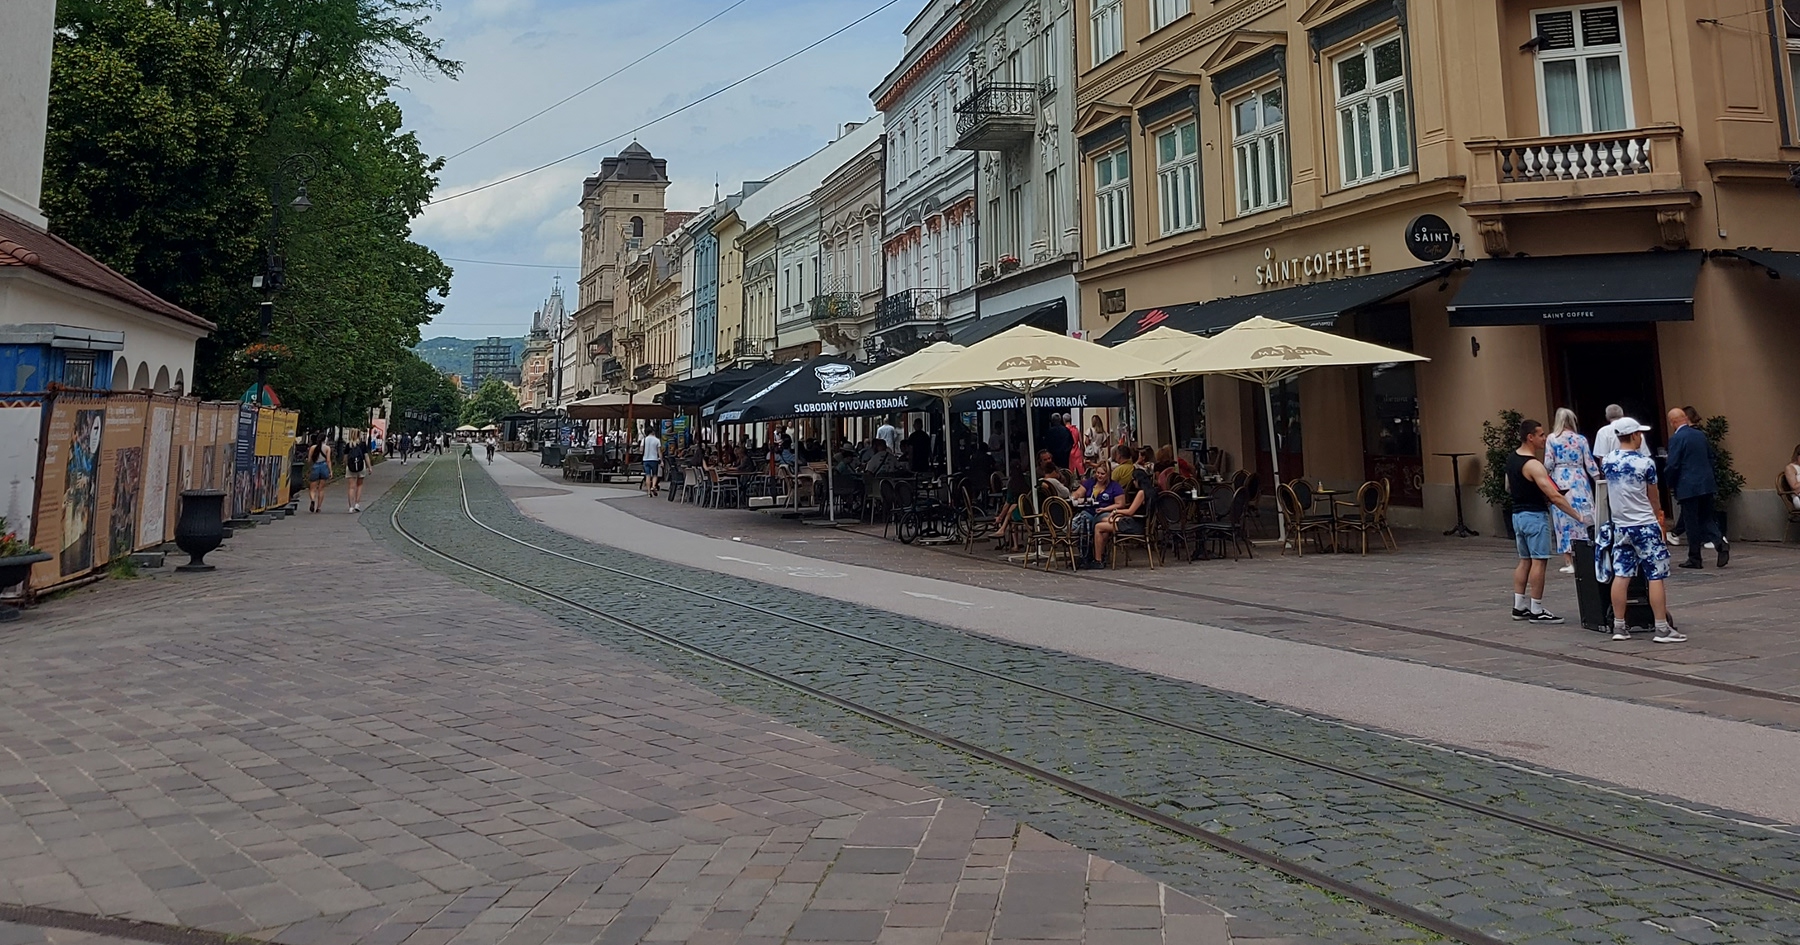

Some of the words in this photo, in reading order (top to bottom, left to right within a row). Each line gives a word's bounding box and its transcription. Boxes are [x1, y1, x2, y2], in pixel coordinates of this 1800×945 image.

[1303, 245, 1367, 277] COFFEE
[794, 400, 838, 413] SLOBODNÝ
[840, 399, 875, 411] PIVOVAR
[876, 395, 909, 409] BRADÁČ
[976, 396, 1019, 410] SLOBODNÝ
[1020, 397, 1055, 408] POVAR
[1055, 394, 1088, 407] BRADÁČ
